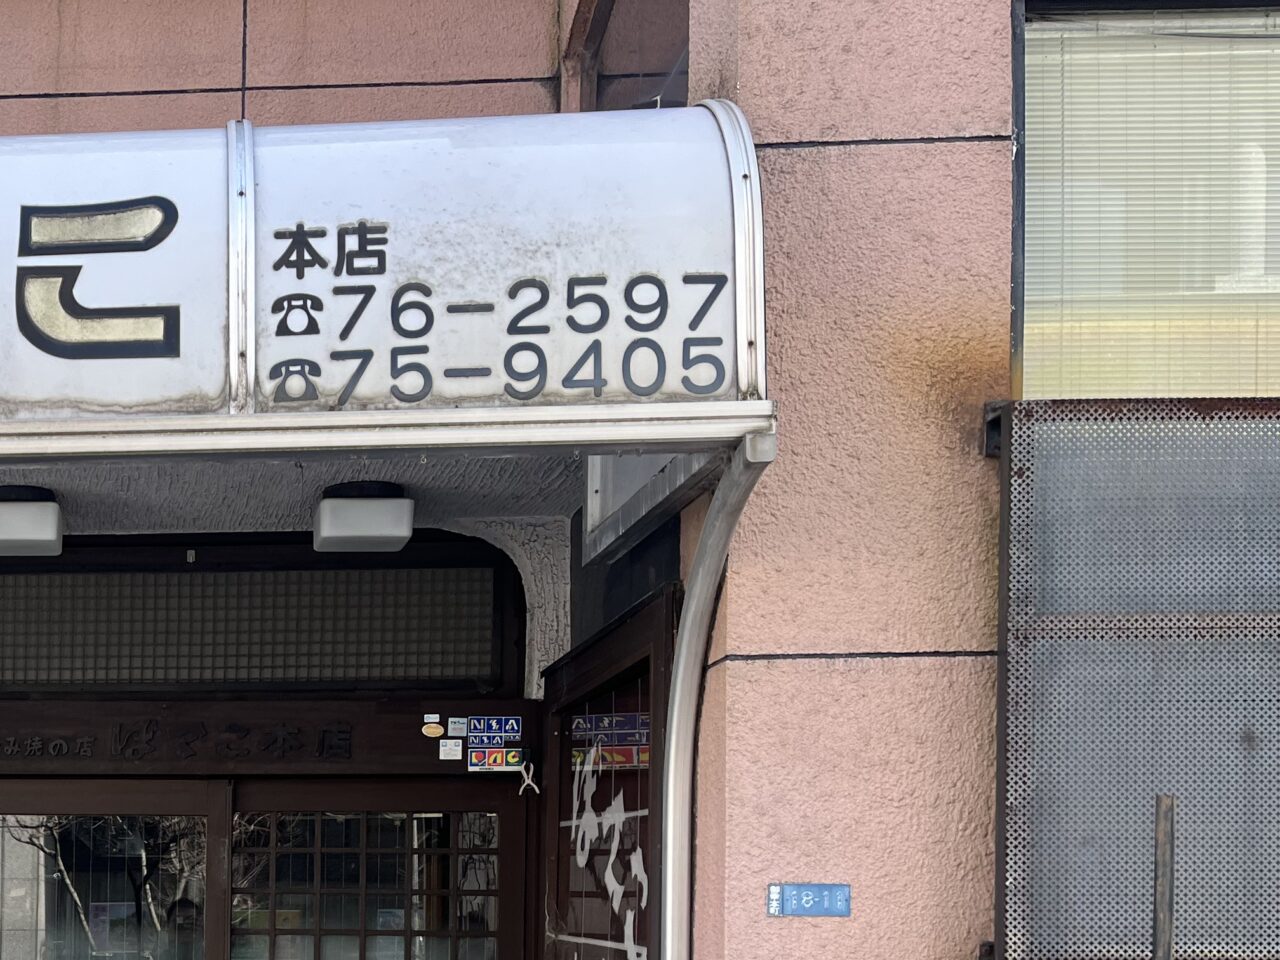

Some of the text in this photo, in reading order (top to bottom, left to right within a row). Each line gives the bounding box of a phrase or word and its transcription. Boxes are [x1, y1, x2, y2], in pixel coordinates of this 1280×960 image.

[272, 221, 389, 280] 本店
[332, 273, 729, 342] 76-2597
[329, 336, 727, 406] 75-9405
